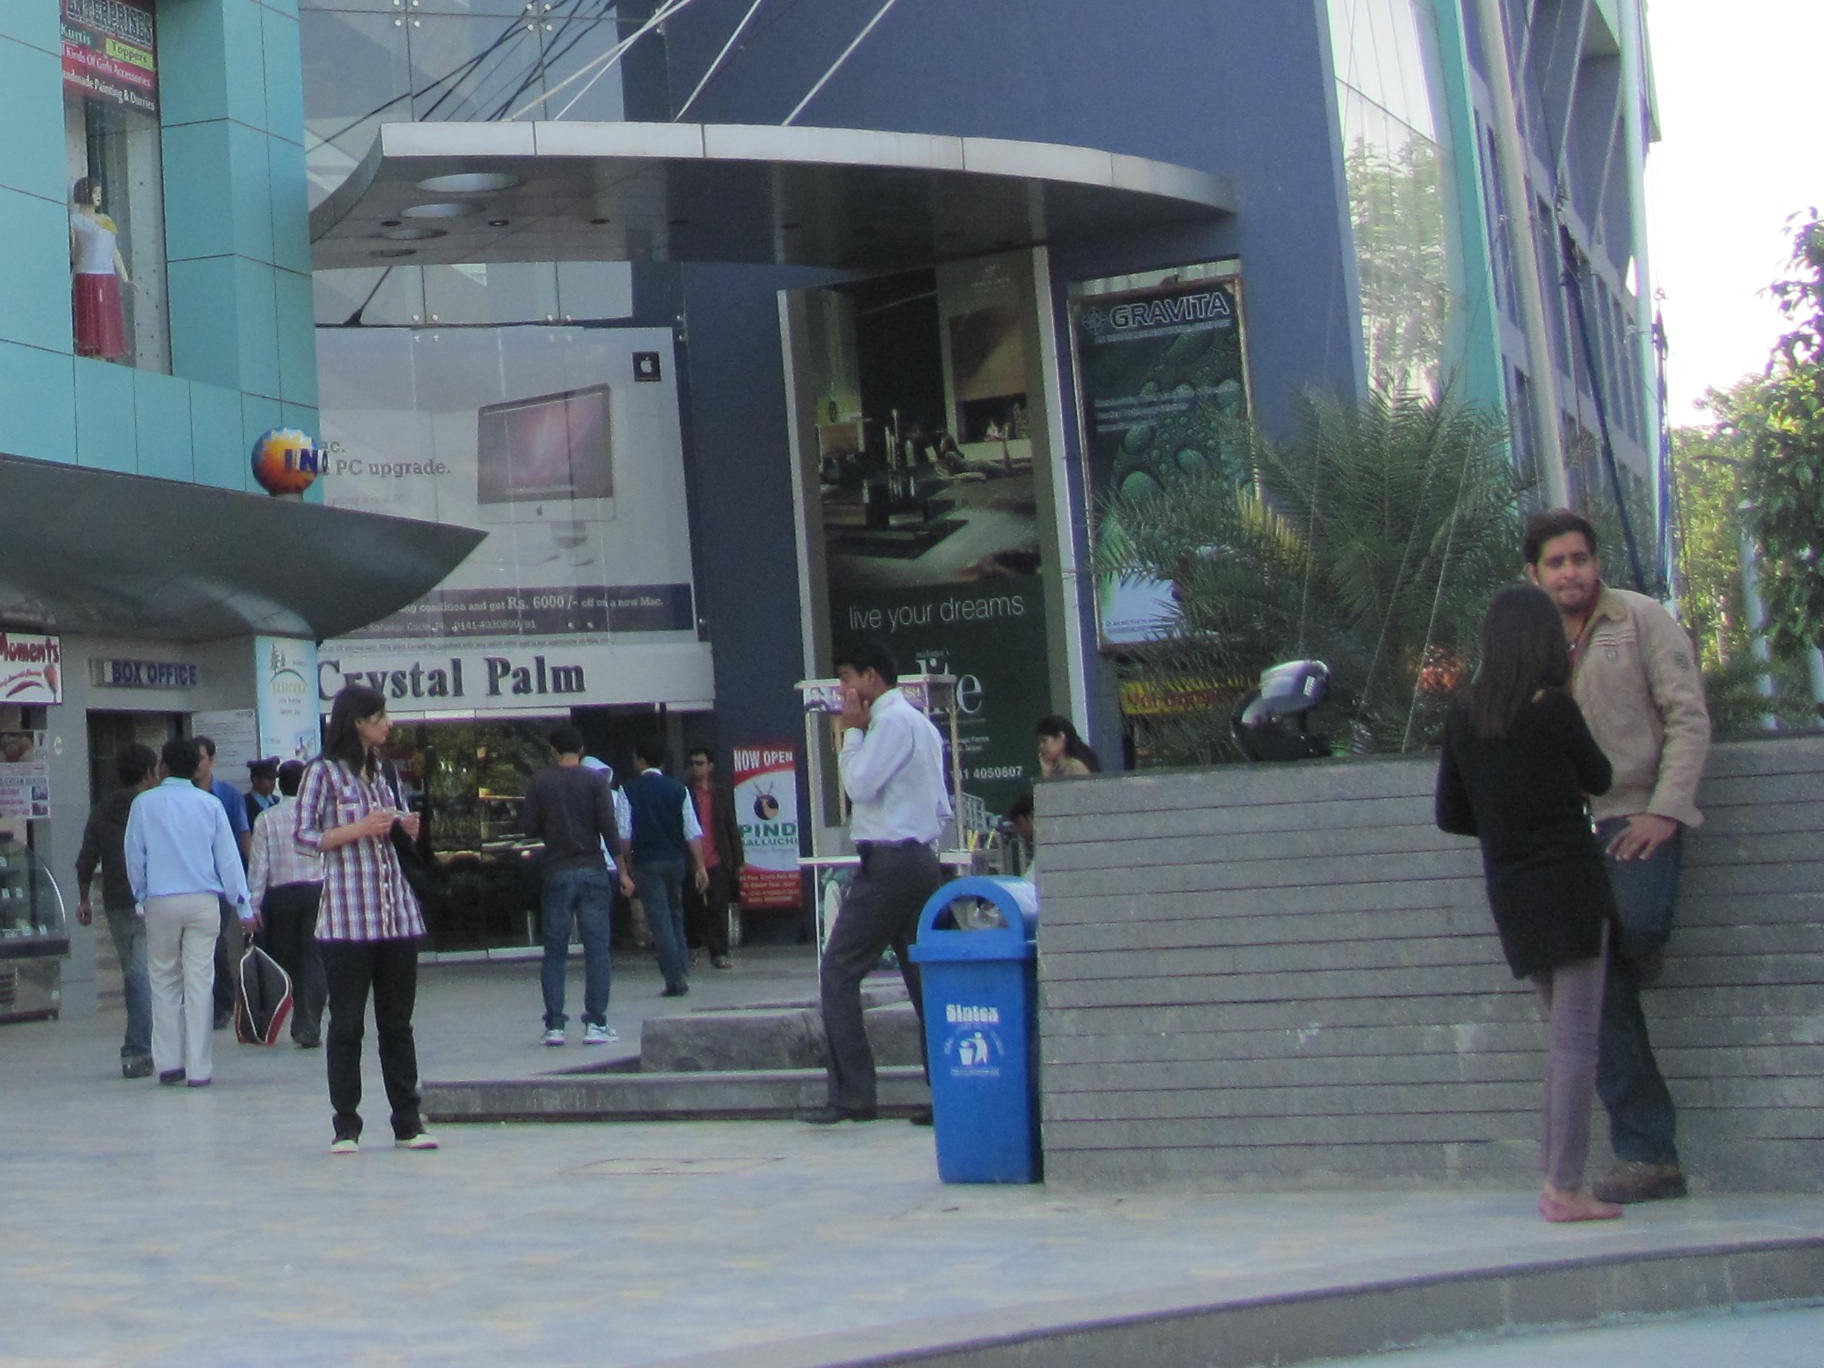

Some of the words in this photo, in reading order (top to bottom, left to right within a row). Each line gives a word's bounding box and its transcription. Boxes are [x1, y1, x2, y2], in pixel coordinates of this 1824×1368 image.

[1109, 291, 1231, 329] GRAVITA
[336, 460, 362, 475] PC
[368, 458, 452, 478] upgrade.
[507, 595, 529, 610] Rs.
[849, 605, 882, 630] live
[887, 602, 933, 633] your
[940, 594, 1025, 623] dreams
[112, 659, 143, 683] BOX
[147, 663, 198, 686] OFFICE
[316, 657, 465, 700] Crystal
[484, 655, 587, 695] Palm
[733, 749, 761, 772] NOW
[763, 750, 794, 767] OPEN
[739, 822, 797, 838] PIND
